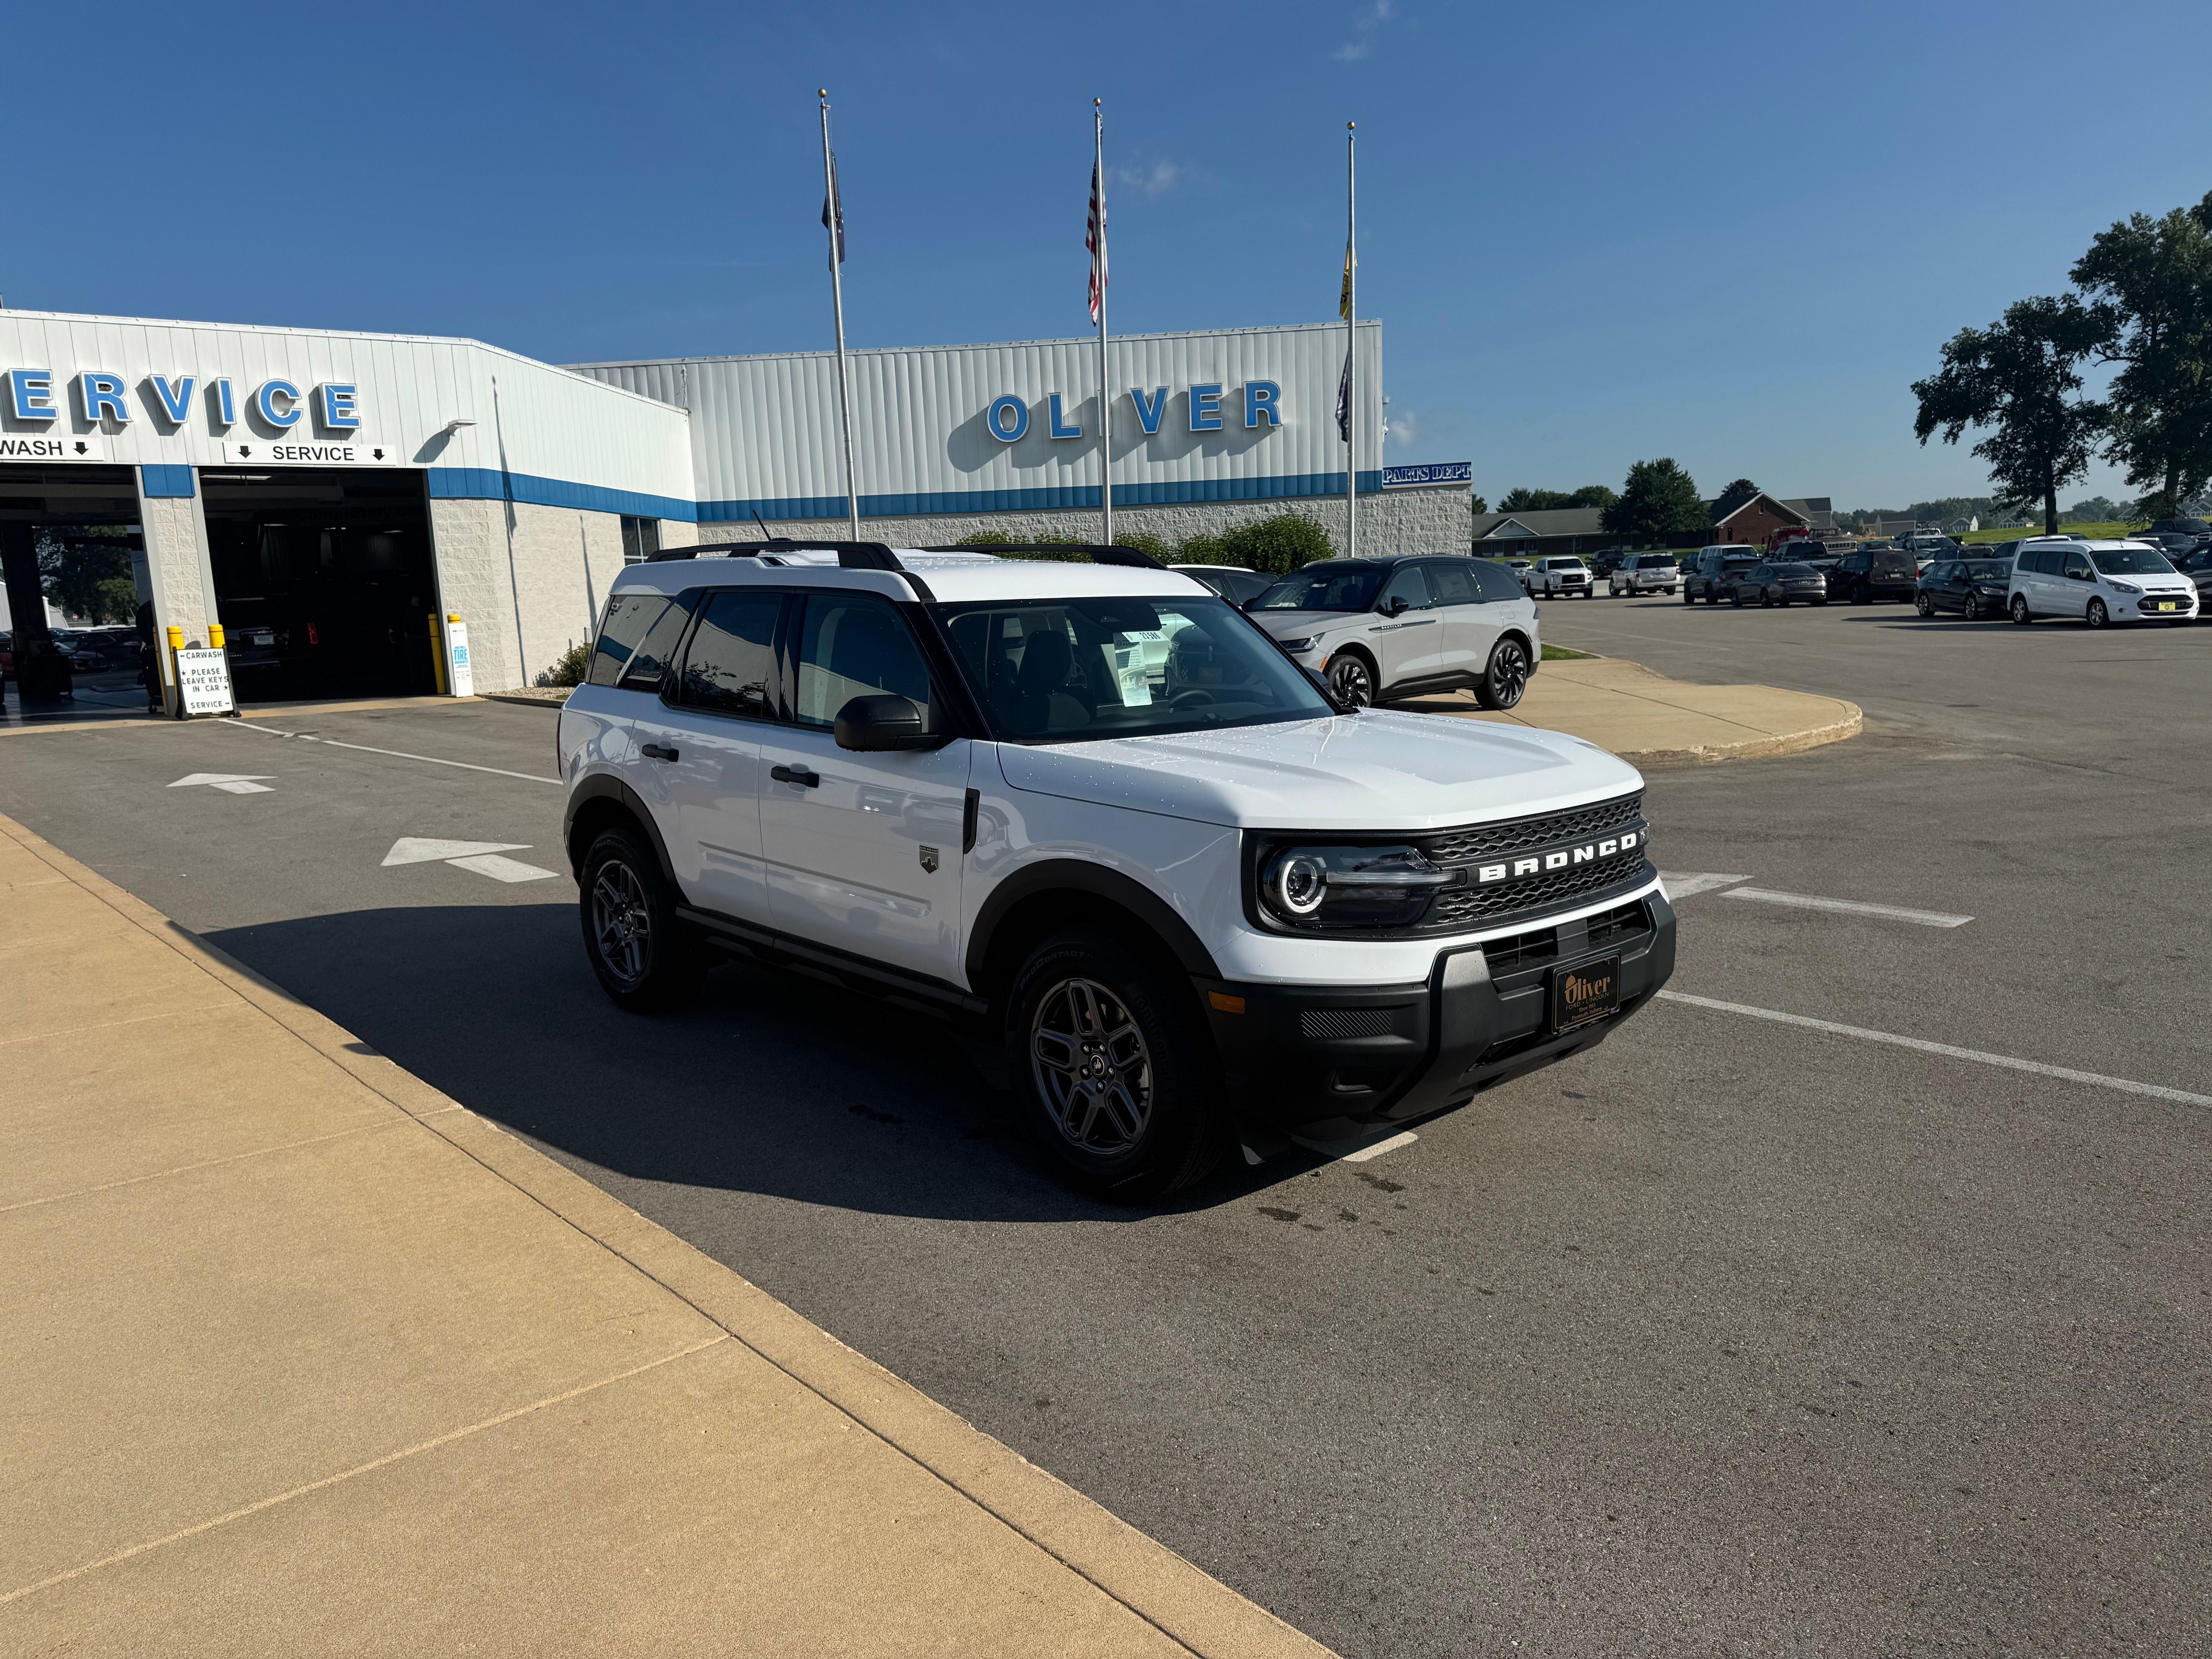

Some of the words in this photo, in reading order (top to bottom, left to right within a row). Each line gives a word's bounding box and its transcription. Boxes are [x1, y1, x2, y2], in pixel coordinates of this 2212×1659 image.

[8, 368, 362, 430] ERVICE
[987, 380, 1283, 443] OLIVER
[273, 446, 355, 461] SERVICE
[1383, 467, 1429, 483] PARTS
[1432, 465, 1471, 480] DEPT
[186, 651, 222, 659] CARWASH
[453, 649, 468, 660] TIRE
[191, 701, 223, 709] SERVICE
[1479, 833, 1637, 883] BRONCO
[1564, 975, 1611, 1004] Oliver
[1566, 1001, 1581, 1011] FORD
[1586, 991, 1609, 1004] LINCOLN
